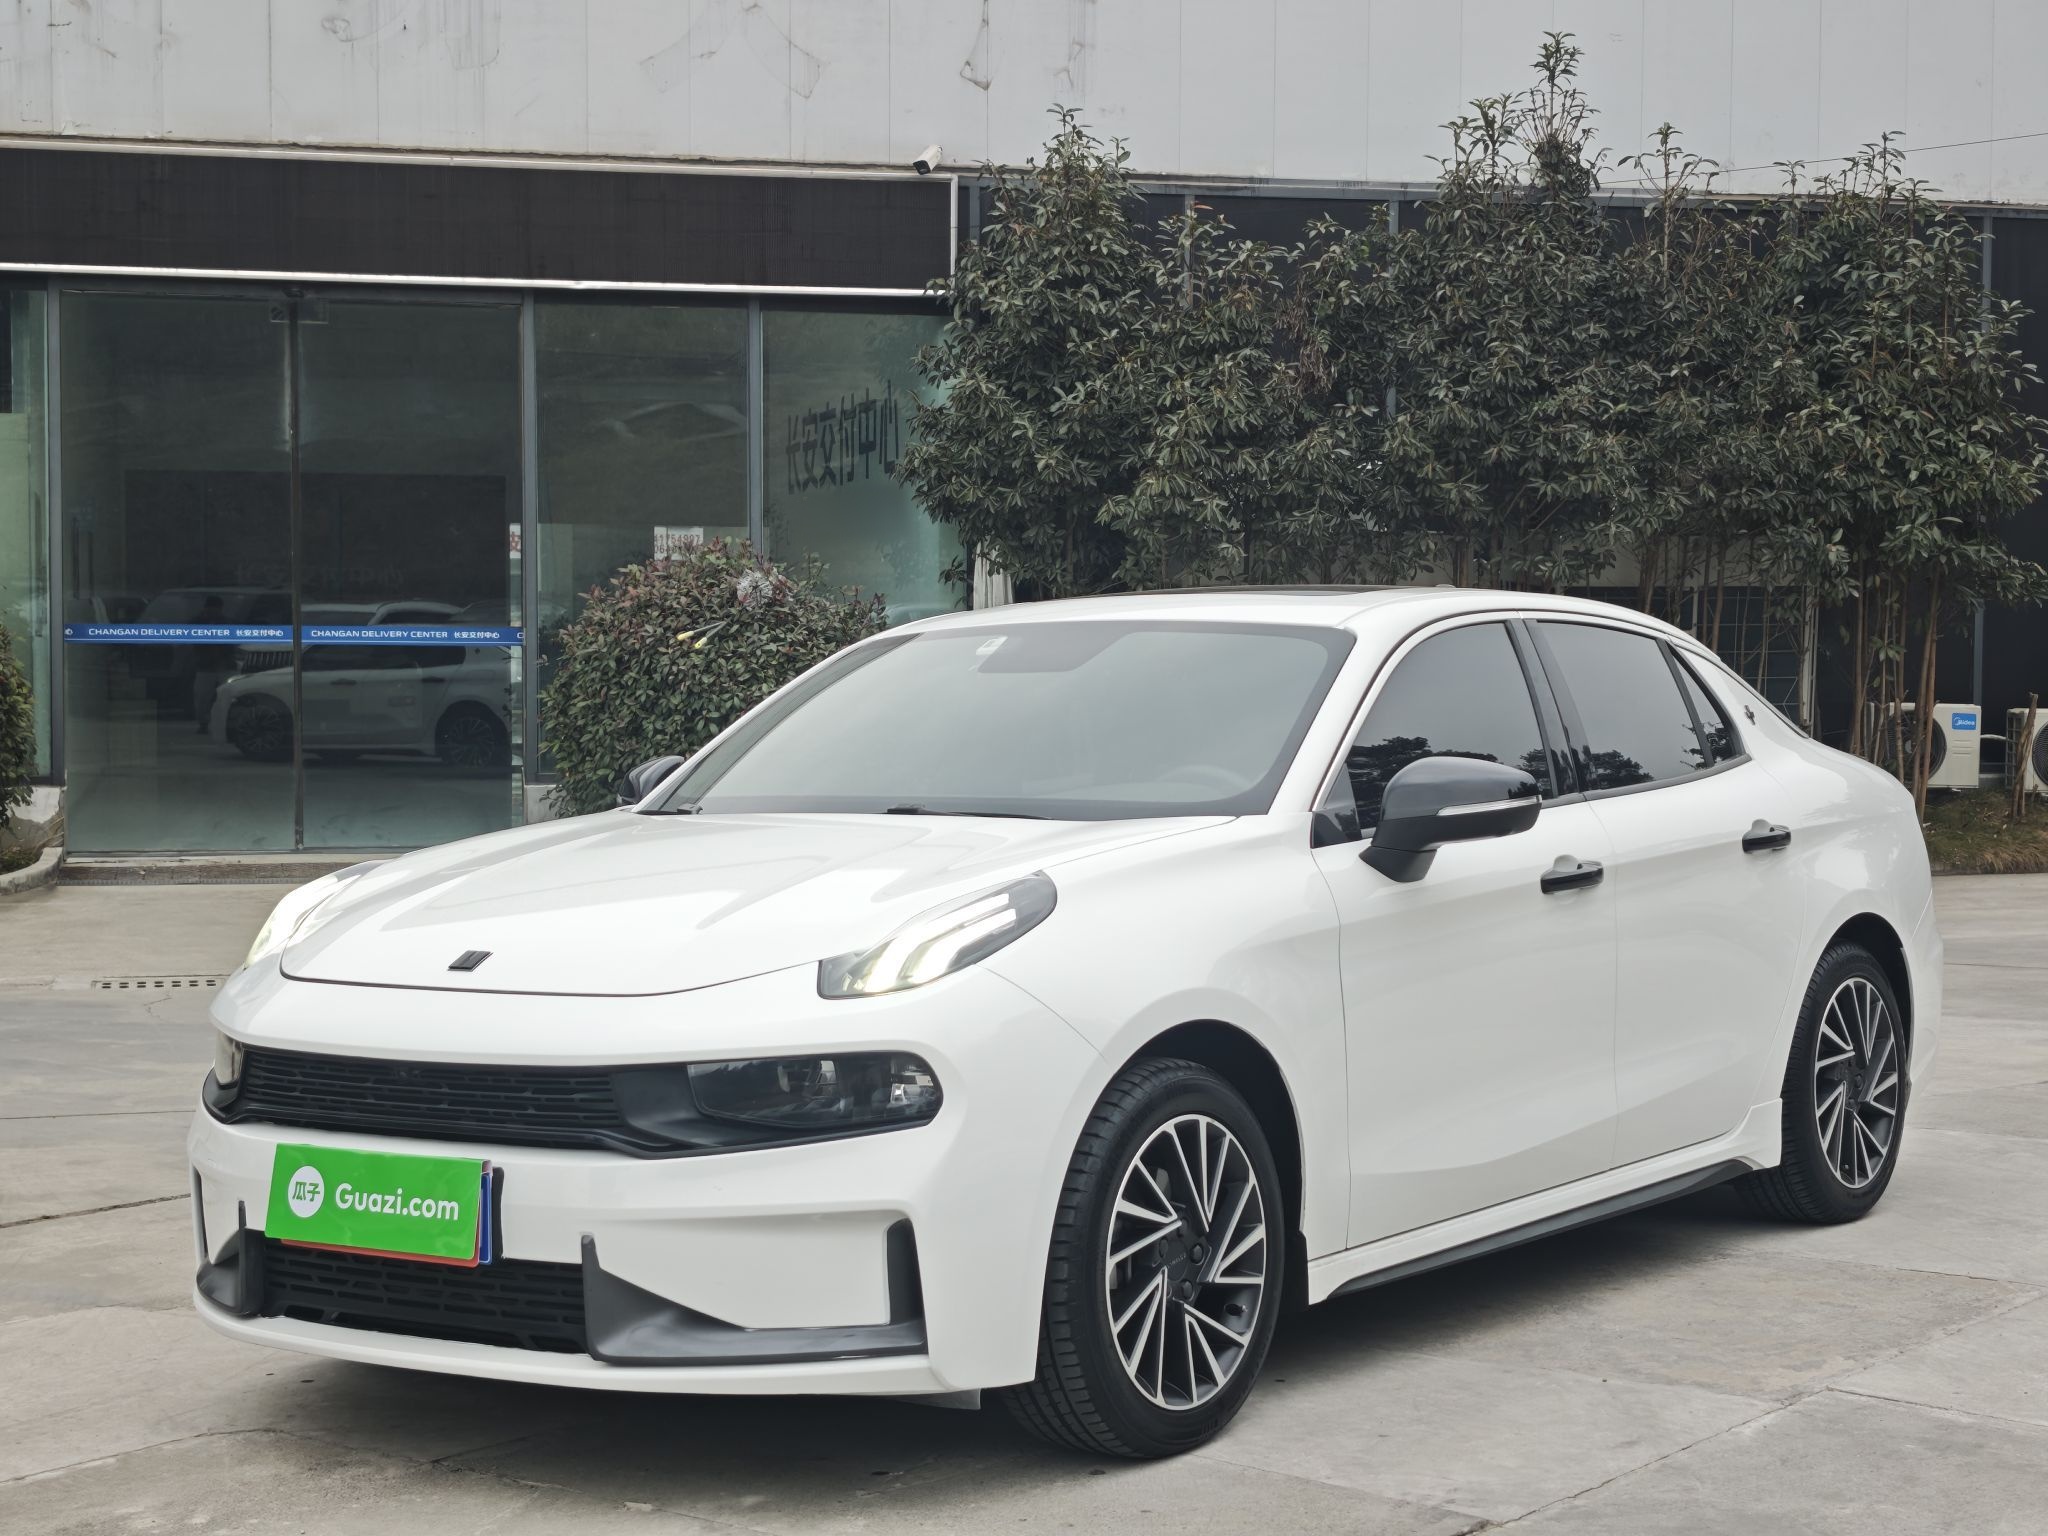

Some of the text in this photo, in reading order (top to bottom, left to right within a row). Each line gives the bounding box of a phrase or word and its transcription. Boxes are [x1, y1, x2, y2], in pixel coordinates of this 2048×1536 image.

[786, 379, 899, 494] 长安交付中心
[88, 628, 284, 637] CHANGAN DELIVERY CENTER 长安交付中心
[311, 630, 500, 639] CHANGAN DELIVERY CENTER 长安交付中心
[292, 1181, 321, 1203] 瓜子
[335, 1182, 459, 1221] Guazi.com
